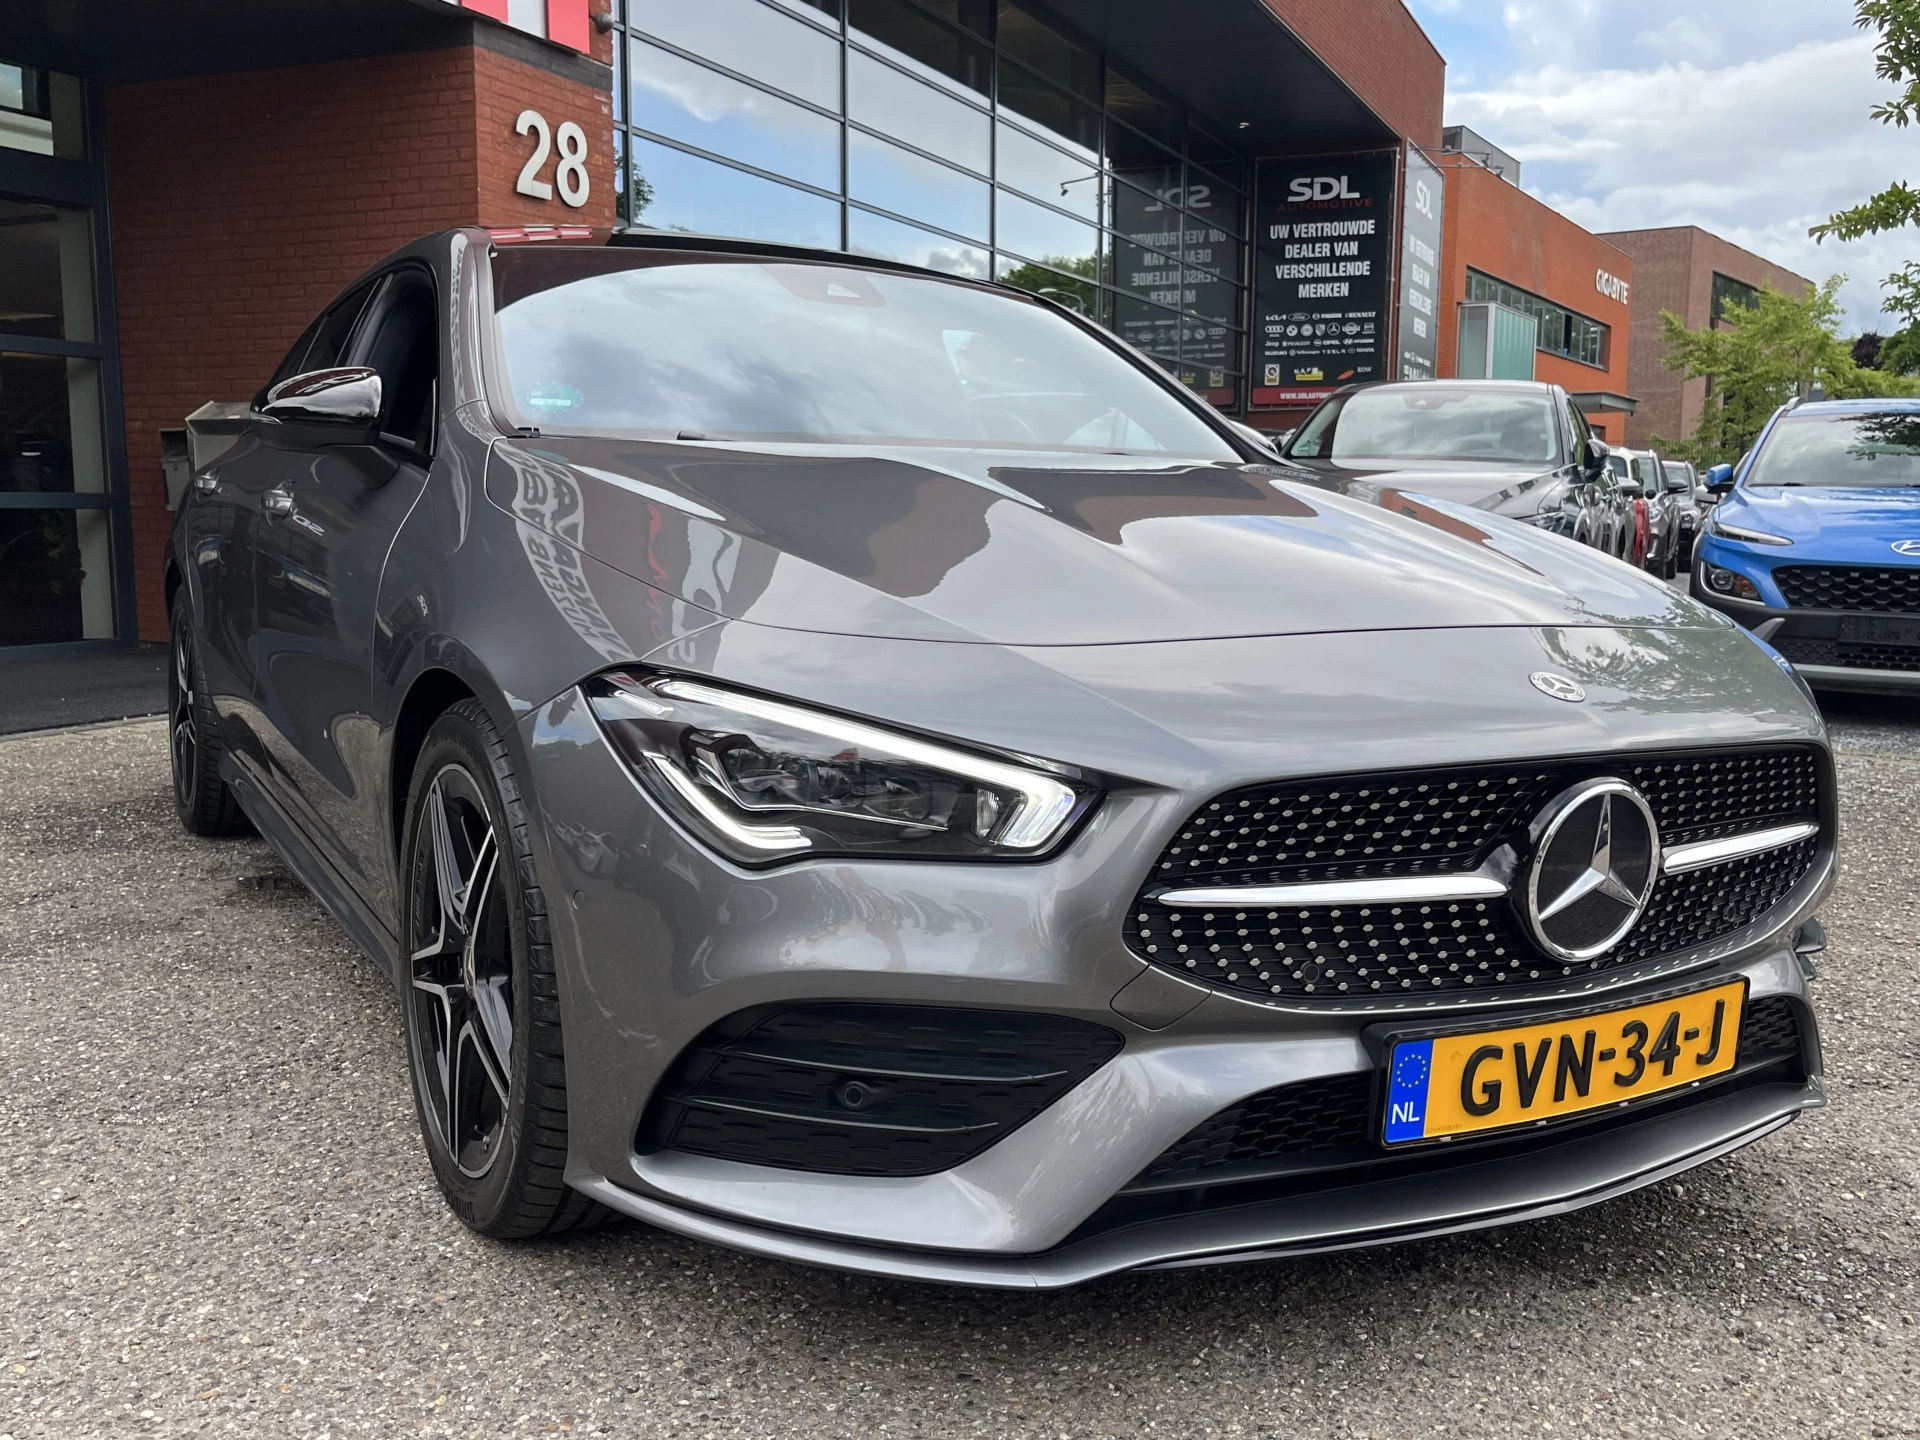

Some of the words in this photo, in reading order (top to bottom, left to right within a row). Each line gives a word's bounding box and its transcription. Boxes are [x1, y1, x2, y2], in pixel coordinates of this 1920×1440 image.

[516, 110, 590, 207] 28
[1287, 175, 1361, 202] SDL
[1277, 198, 1373, 212] AUTOMOTIVE
[1415, 179, 1433, 221] SDL
[1269, 224, 1290, 239] UW
[1293, 219, 1376, 238] VERTROUWDE
[1285, 243, 1331, 259] DEALER
[1334, 241, 1359, 257] VAN
[1275, 260, 1371, 279] VERSCHILLENDE
[1298, 282, 1350, 299] MERKEN
[1460, 999, 1726, 1117] GVN-34-J
[1391, 1101, 1420, 1124] NL
